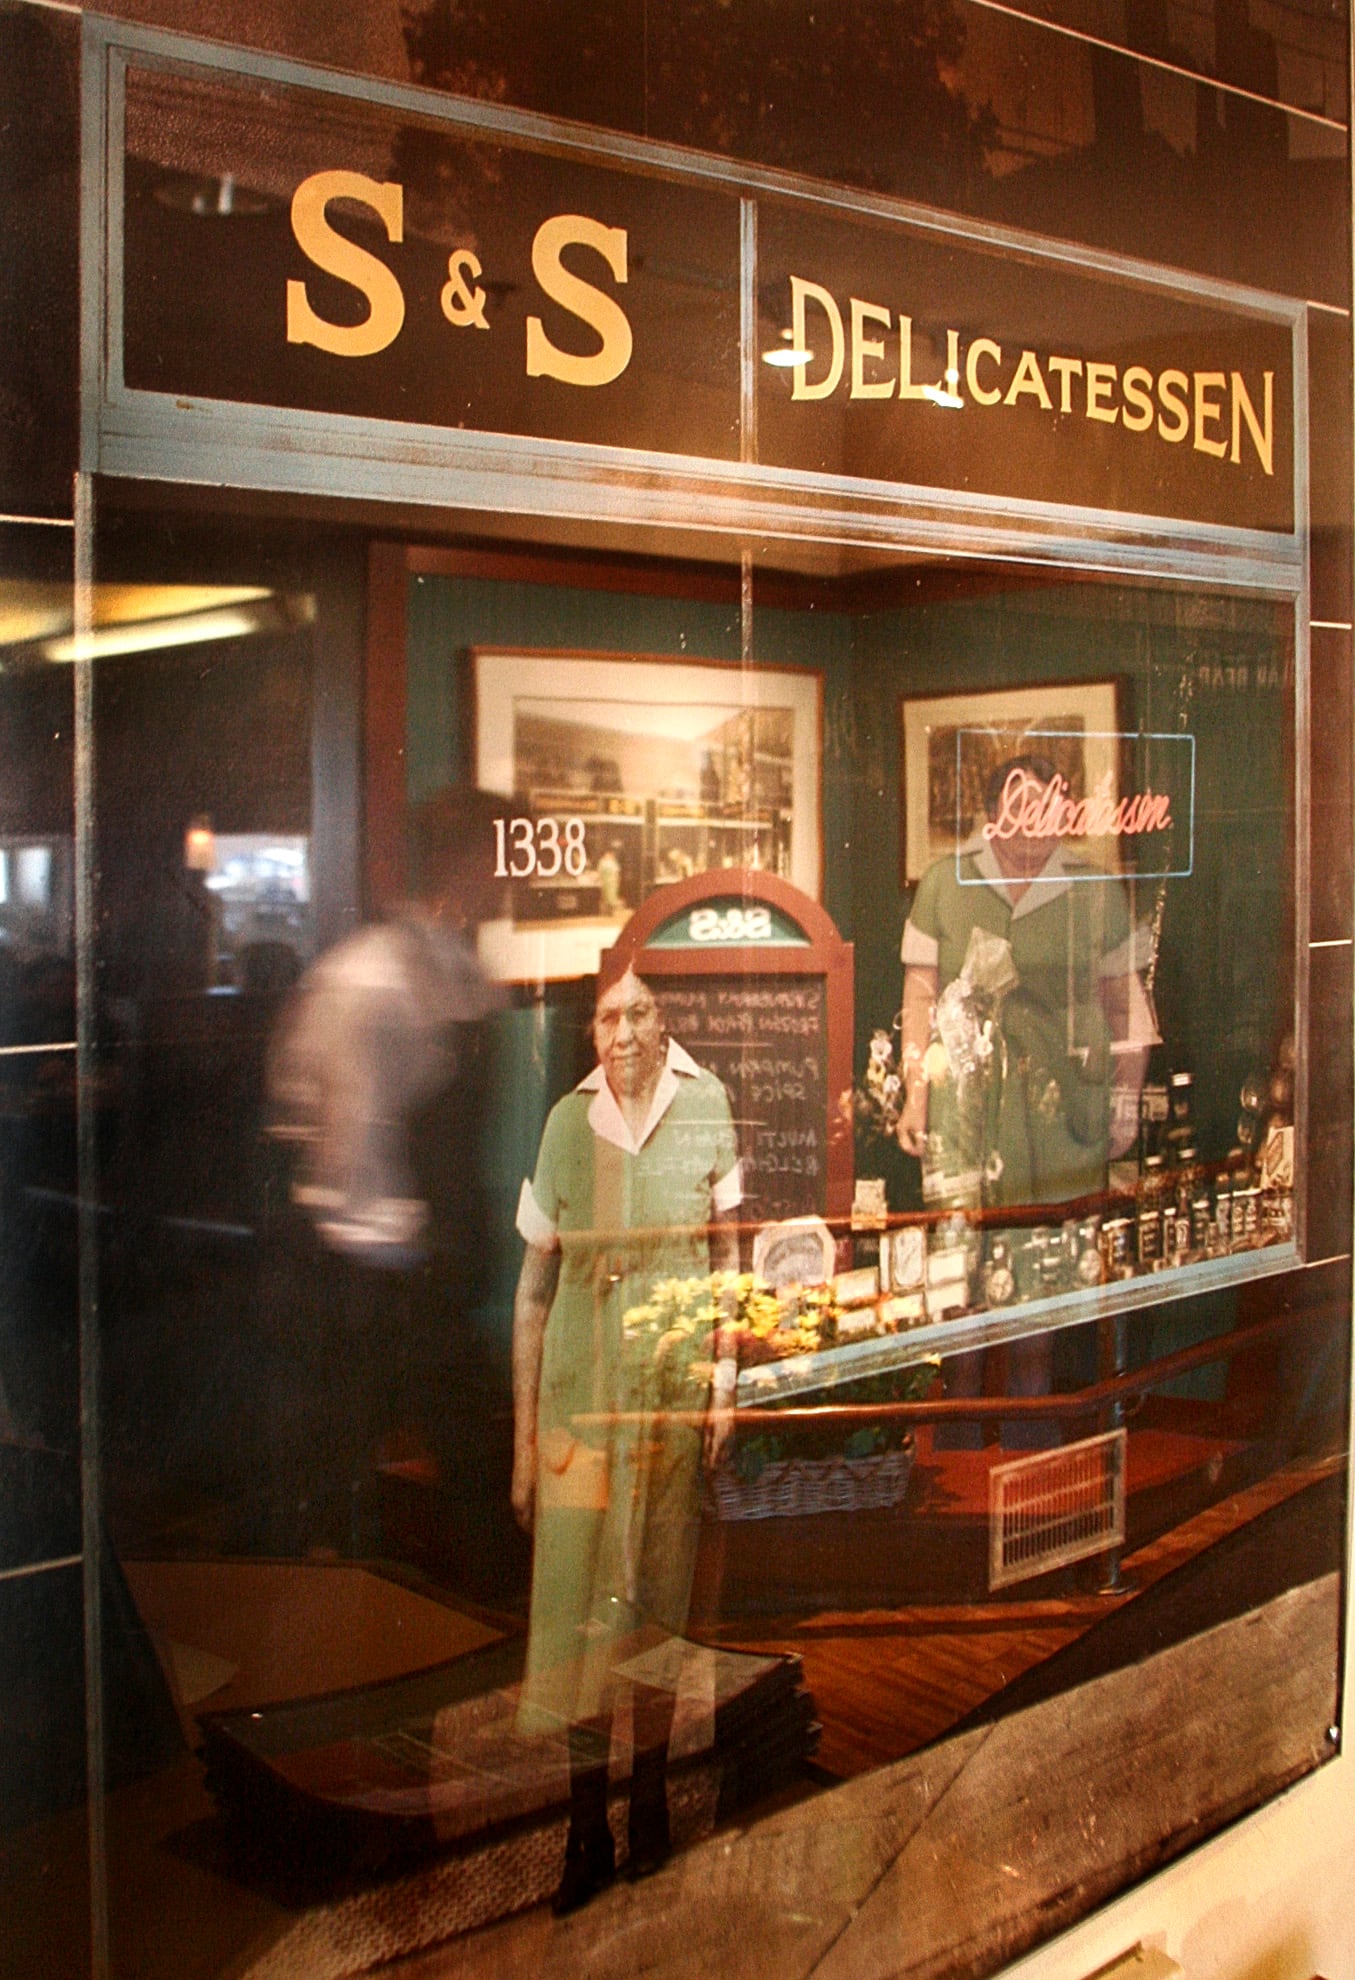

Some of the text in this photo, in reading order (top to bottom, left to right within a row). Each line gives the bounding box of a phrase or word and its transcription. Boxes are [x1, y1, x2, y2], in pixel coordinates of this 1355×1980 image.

[287, 170, 1274, 475] S & S DELICATESSEN
[493, 817, 587, 877] 1338
